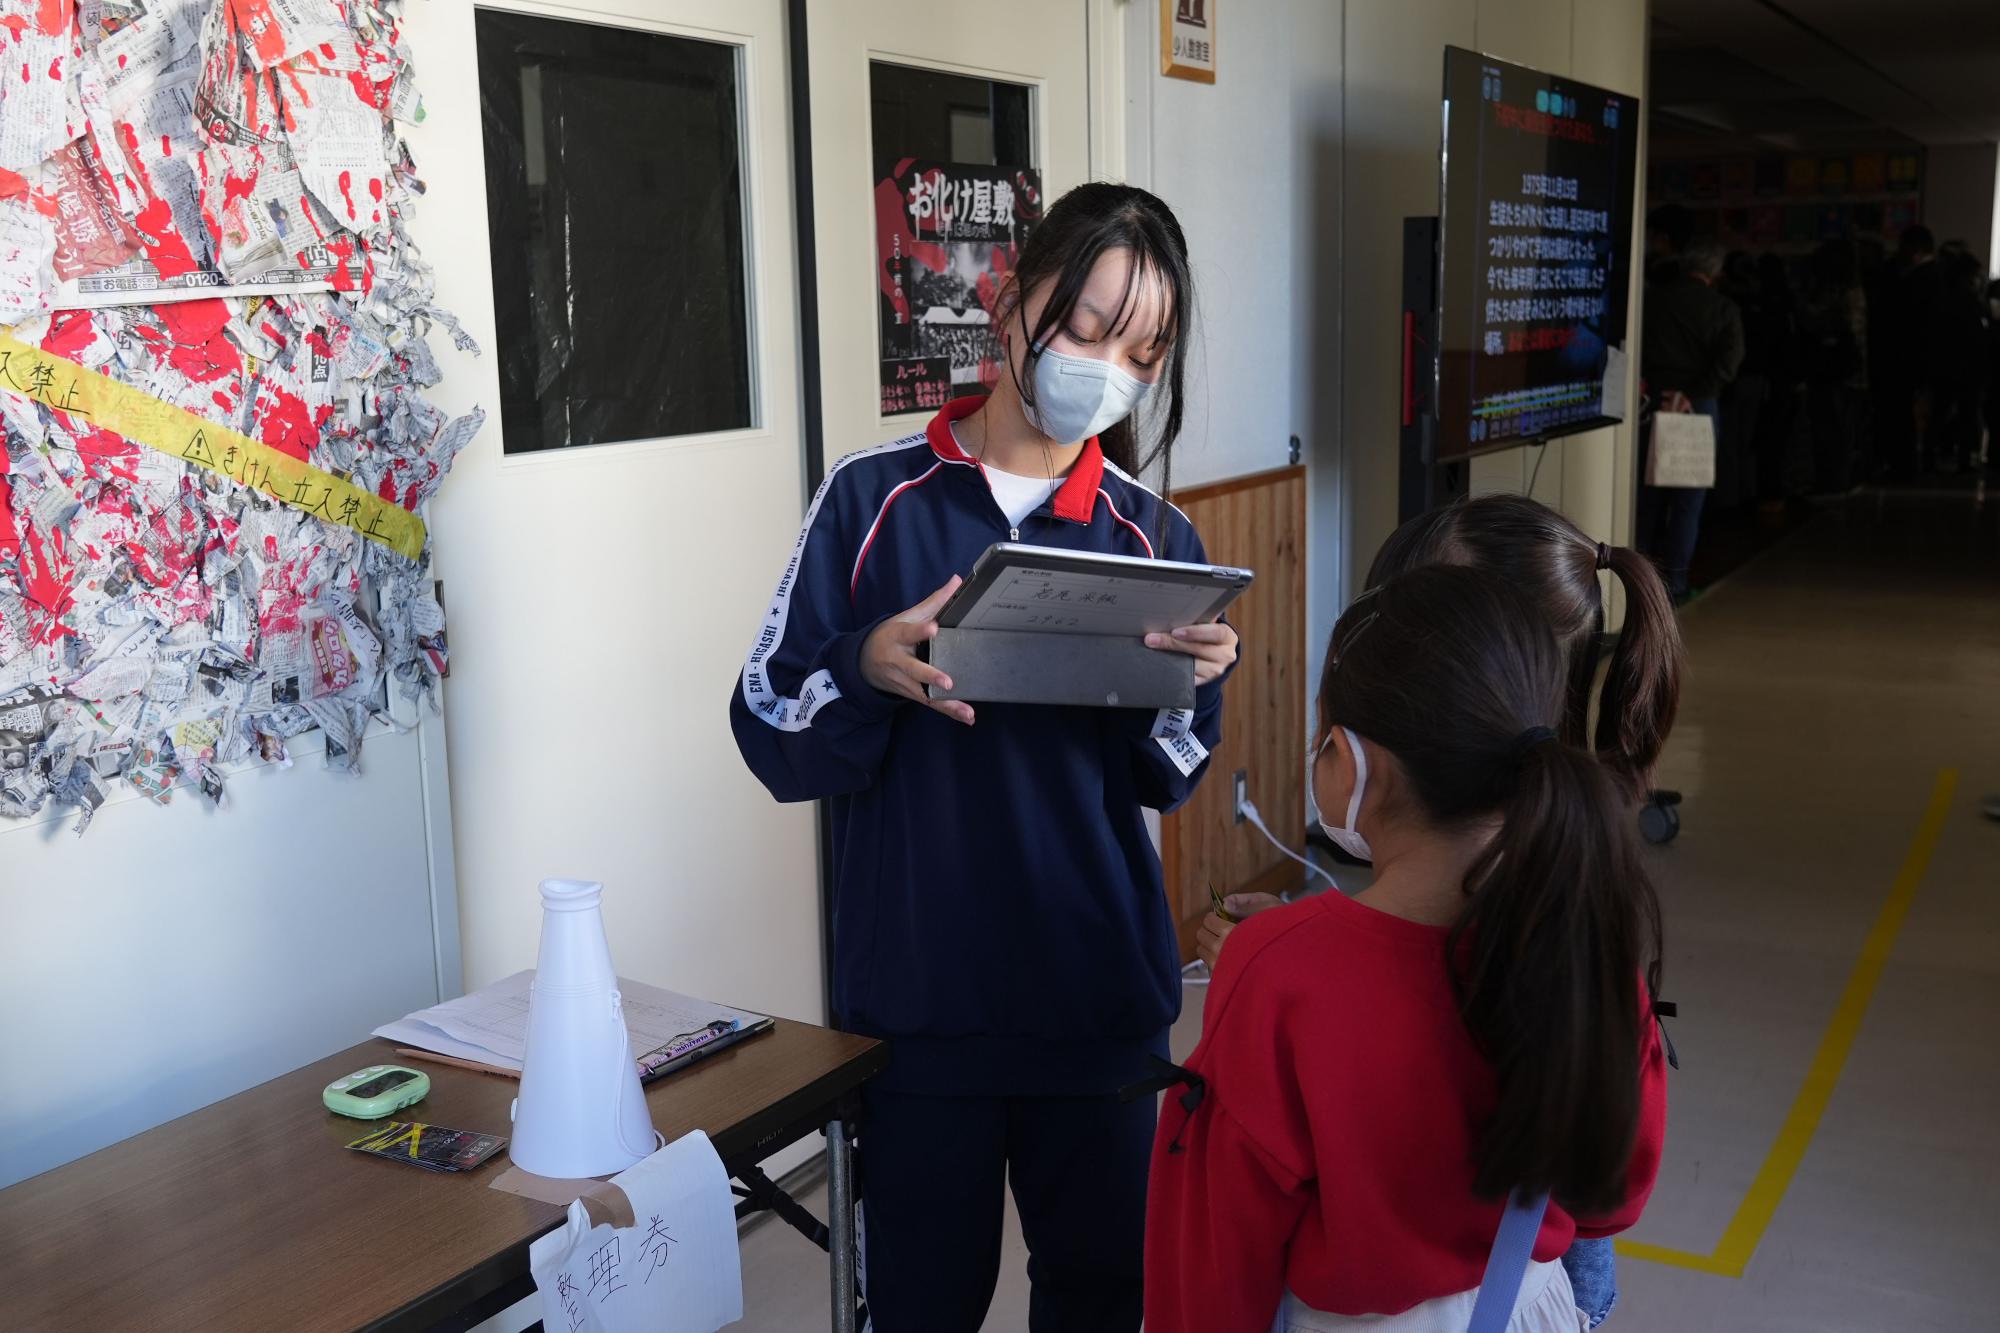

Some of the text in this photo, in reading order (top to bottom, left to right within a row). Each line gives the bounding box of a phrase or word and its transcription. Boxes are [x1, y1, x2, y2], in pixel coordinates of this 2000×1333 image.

[908, 172, 1016, 226] お化け屋敷
[896, 362, 928, 379] ルール
[776, 557, 798, 598] HIGASHI
[748, 624, 778, 694] ENA HIGASHI
[674, 1033, 709, 1053] HAMAZUSHI
[556, 1213, 679, 1333] 整理券
